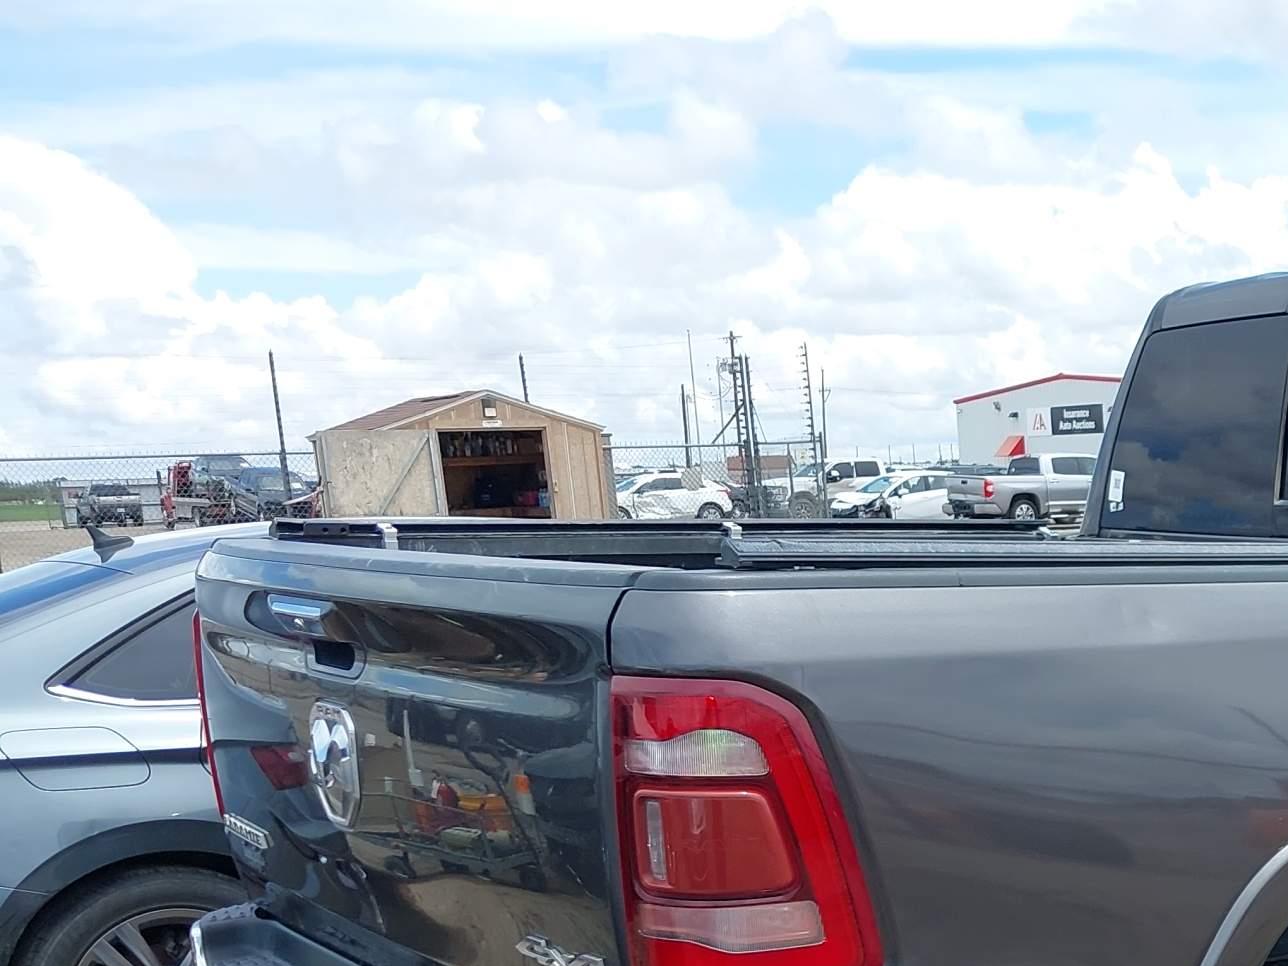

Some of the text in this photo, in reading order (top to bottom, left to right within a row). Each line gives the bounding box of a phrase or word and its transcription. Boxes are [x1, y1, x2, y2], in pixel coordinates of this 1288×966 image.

[1063, 408, 1090, 419] Insurance
[1059, 419, 1096, 431] Auto Auctions
